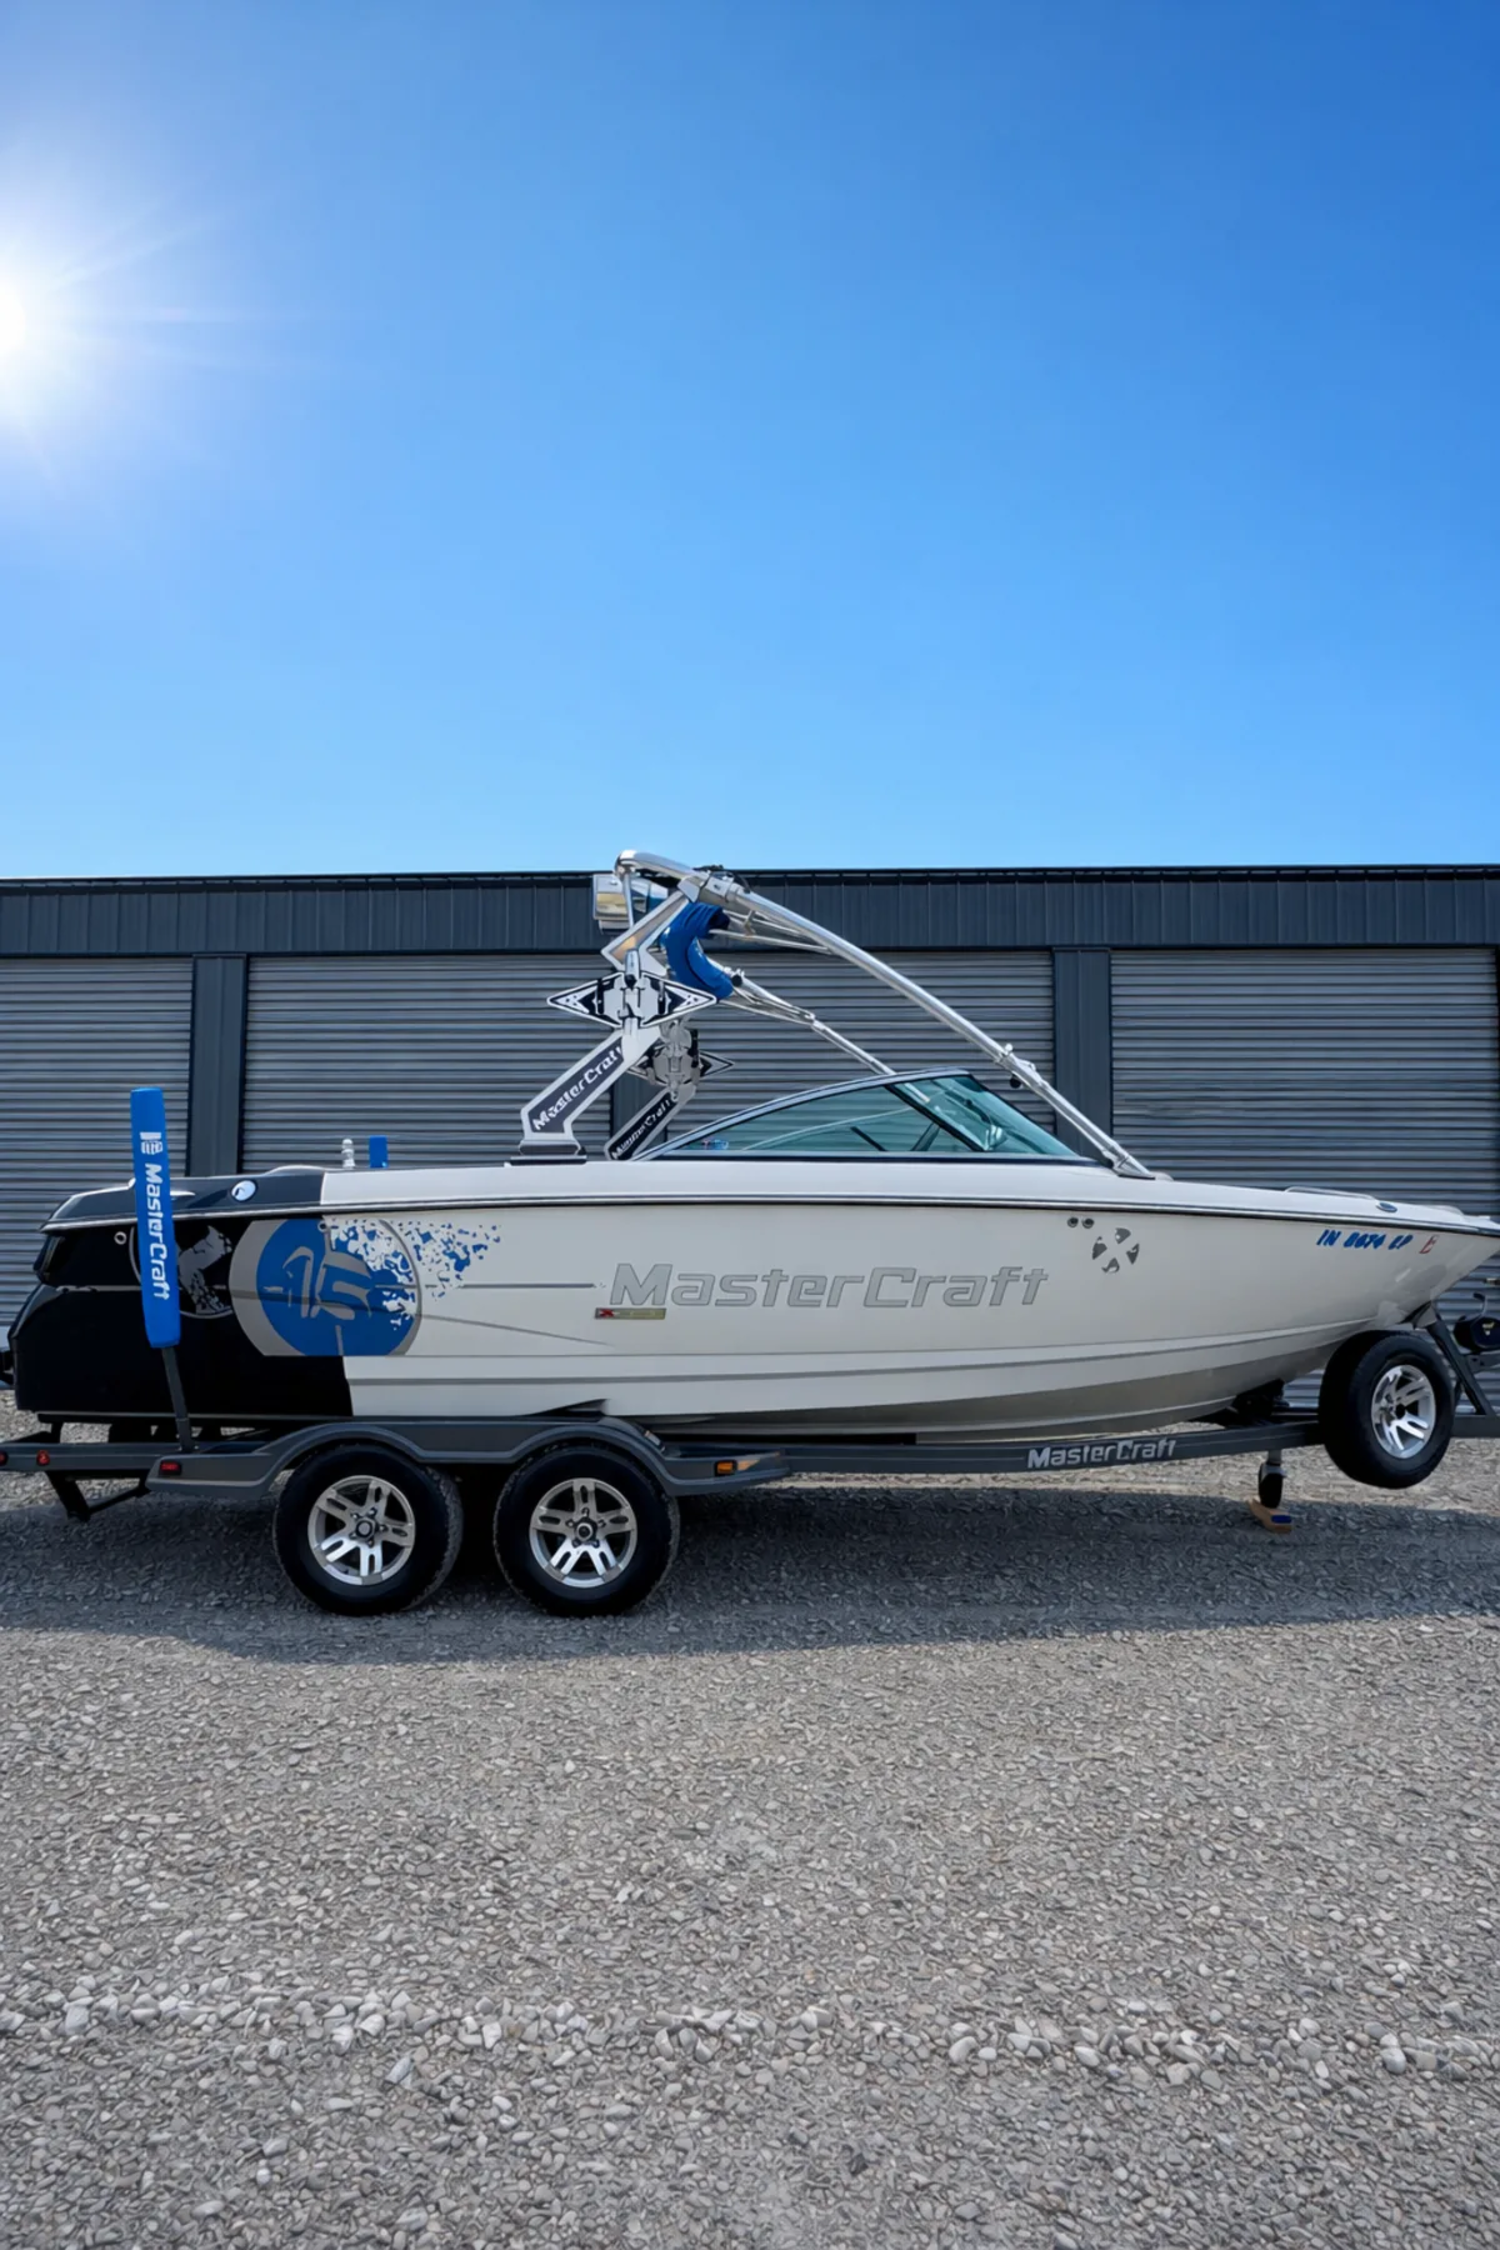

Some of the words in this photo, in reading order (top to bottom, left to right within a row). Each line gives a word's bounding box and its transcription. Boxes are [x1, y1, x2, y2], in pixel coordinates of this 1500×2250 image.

[145, 1162, 170, 1300] MasterCraft
[1316, 1229, 1342, 1247] IN
[609, 1263, 1049, 1308] MasterCraft
[1027, 1438, 1177, 1469] MasterCraft
